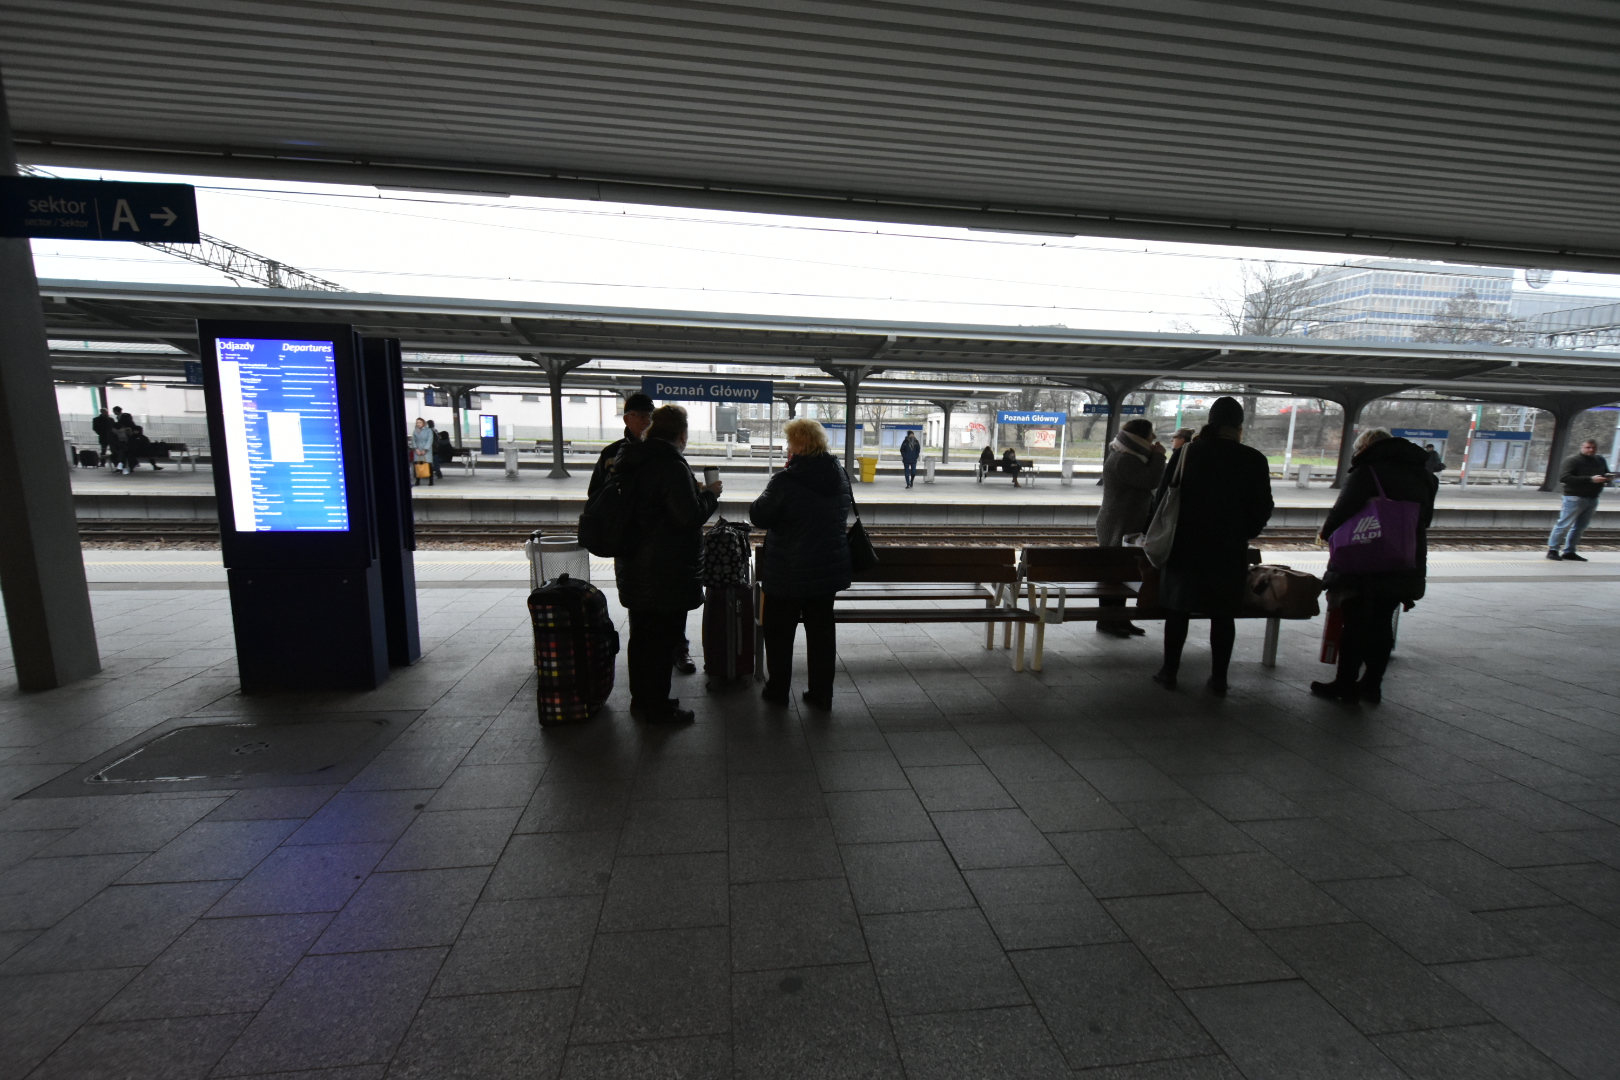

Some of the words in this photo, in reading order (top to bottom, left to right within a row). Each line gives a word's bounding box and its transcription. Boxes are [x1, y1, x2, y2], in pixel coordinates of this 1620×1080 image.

[28, 196, 87, 214] sektor
[112, 198, 140, 232] A
[24, 218, 52, 226] sector
[60, 218, 88, 228] Sektor
[219, 342, 254, 352] Odjazdy
[282, 343, 332, 353] Departures
[656, 383, 704, 396] Poznań
[710, 385, 759, 400] Główny
[1032, 414, 1058, 424] Główny
[1351, 530, 1382, 541] ALDI
